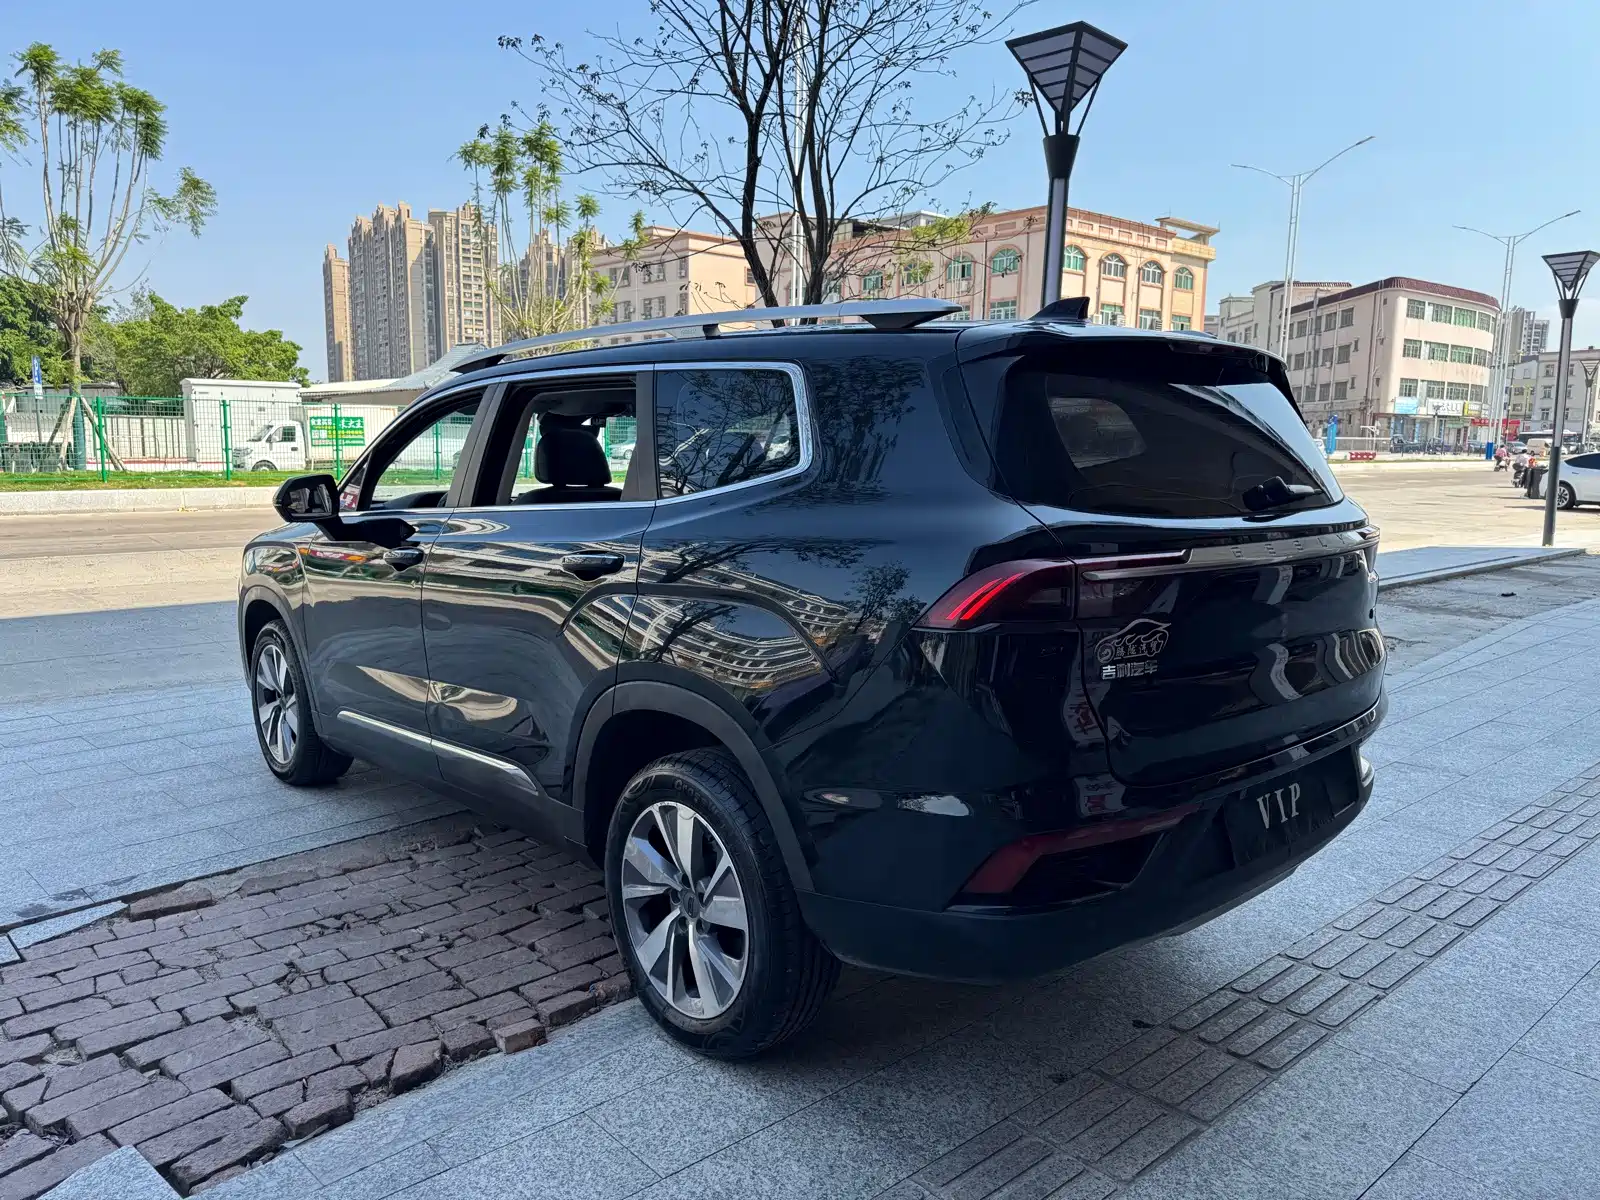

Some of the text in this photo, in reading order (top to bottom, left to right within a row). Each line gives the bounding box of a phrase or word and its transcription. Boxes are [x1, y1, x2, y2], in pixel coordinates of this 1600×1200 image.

[1102, 659, 1158, 680] 吉利汽车
[1256, 782, 1300, 829] VIP
